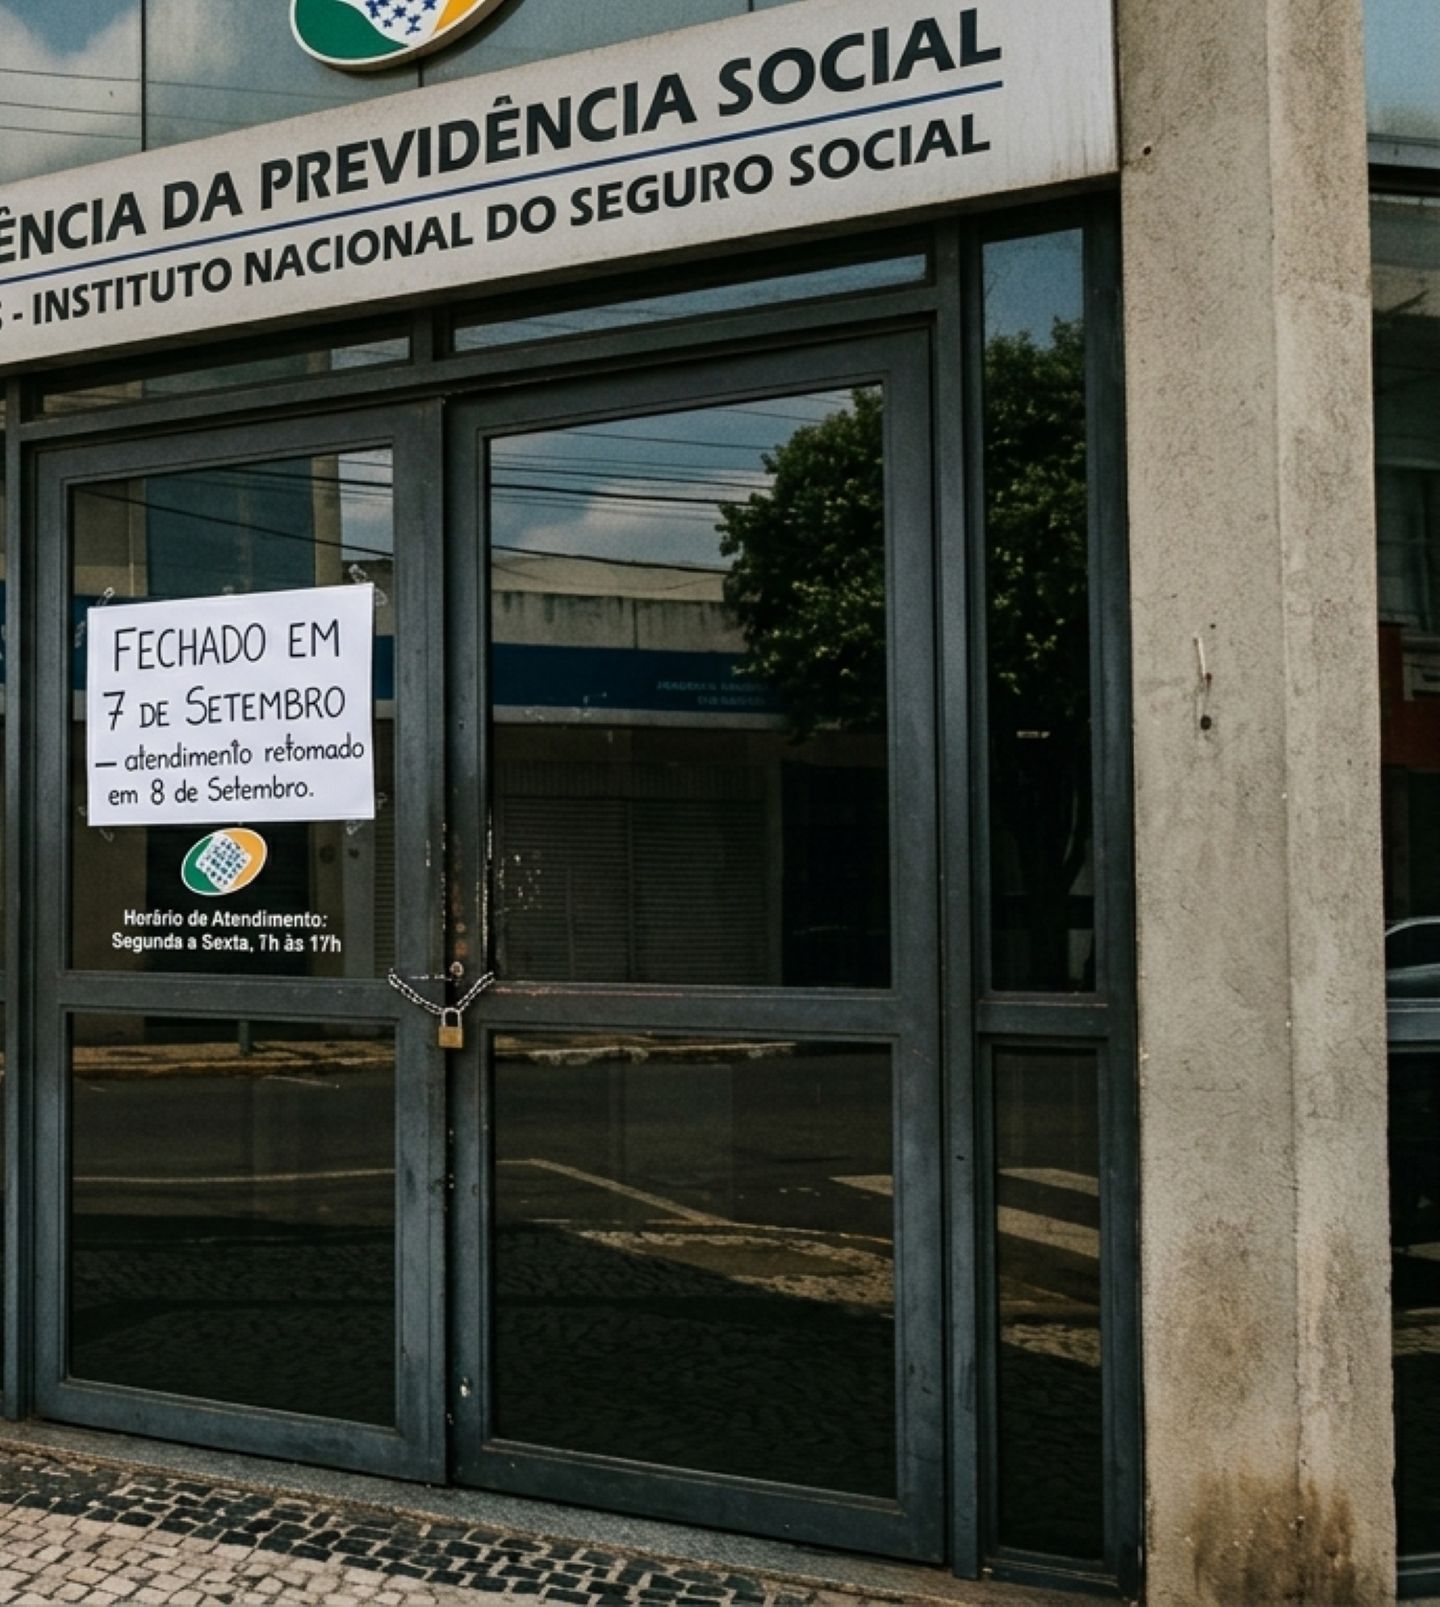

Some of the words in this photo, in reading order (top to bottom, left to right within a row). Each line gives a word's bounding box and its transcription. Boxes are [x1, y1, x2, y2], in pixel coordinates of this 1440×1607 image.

[164, 172, 243, 231] DA
[260, 72, 698, 211] PREVIDÊNCIA
[718, 7, 1002, 117] SOCIAL
[33, 258, 232, 325] INSTITUTO
[244, 212, 474, 287] NACIONAL
[487, 195, 557, 241] DO
[570, 154, 773, 227] SEGURO
[790, 113, 991, 187] SOCIAL
[114, 622, 266, 672] FECHADO
[289, 618, 340, 658] EM
[103, 690, 126, 731] 7
[139, 700, 170, 729] DE
[185, 685, 346, 726] SETEMBRO
[124, 739, 253, 772] atendimento
[264, 732, 365, 762] retomado
[108, 789, 138, 806] em
[150, 778, 165, 806] 8
[174, 779, 198, 804] de
[208, 774, 314, 802] Setembro.
[123, 909, 184, 926] Horário
[187, 909, 208, 926] de
[212, 909, 328, 928] Atendimento:
[111, 931, 182, 953] Segunda
[187, 936, 197, 950] a
[201, 933, 254, 953] Sexta,
[258, 934, 279, 951] 7h
[284, 933, 304, 952] às
[310, 934, 342, 952] 17h
